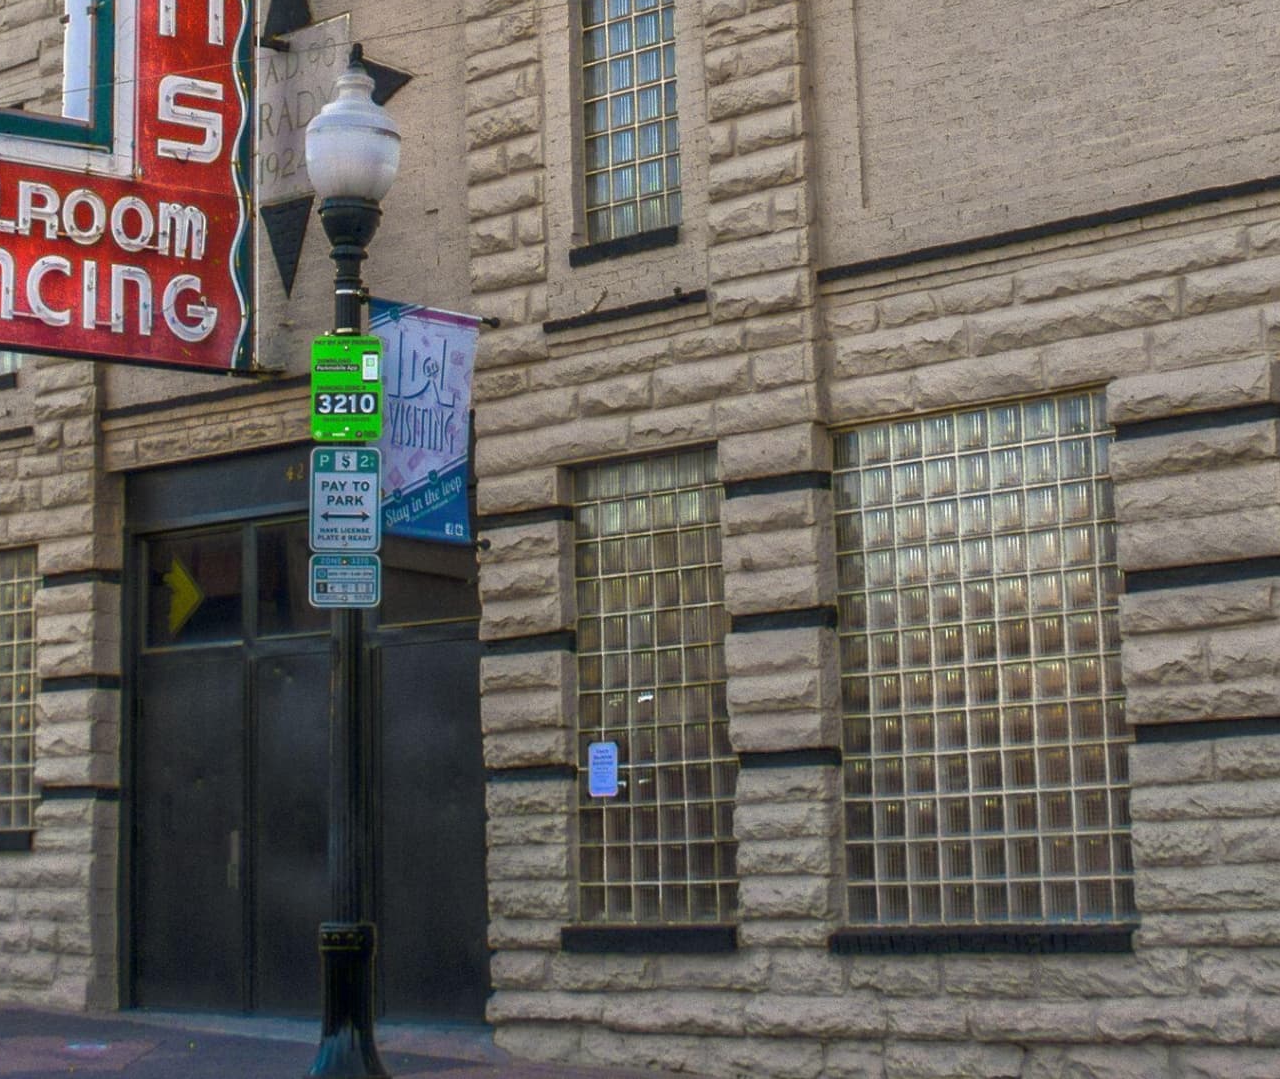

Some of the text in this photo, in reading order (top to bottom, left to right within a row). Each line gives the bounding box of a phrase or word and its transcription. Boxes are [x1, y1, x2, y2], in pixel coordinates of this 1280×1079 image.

[317, 393, 375, 414] 3210
[319, 455, 330, 468] P
[341, 454, 351, 469] $
[321, 481, 371, 492] PAY TO
[327, 495, 364, 506] PARK
[385, 504, 411, 527] Stay
[411, 496, 424, 513] in
[424, 488, 441, 506] the
[441, 476, 463, 496] loop
